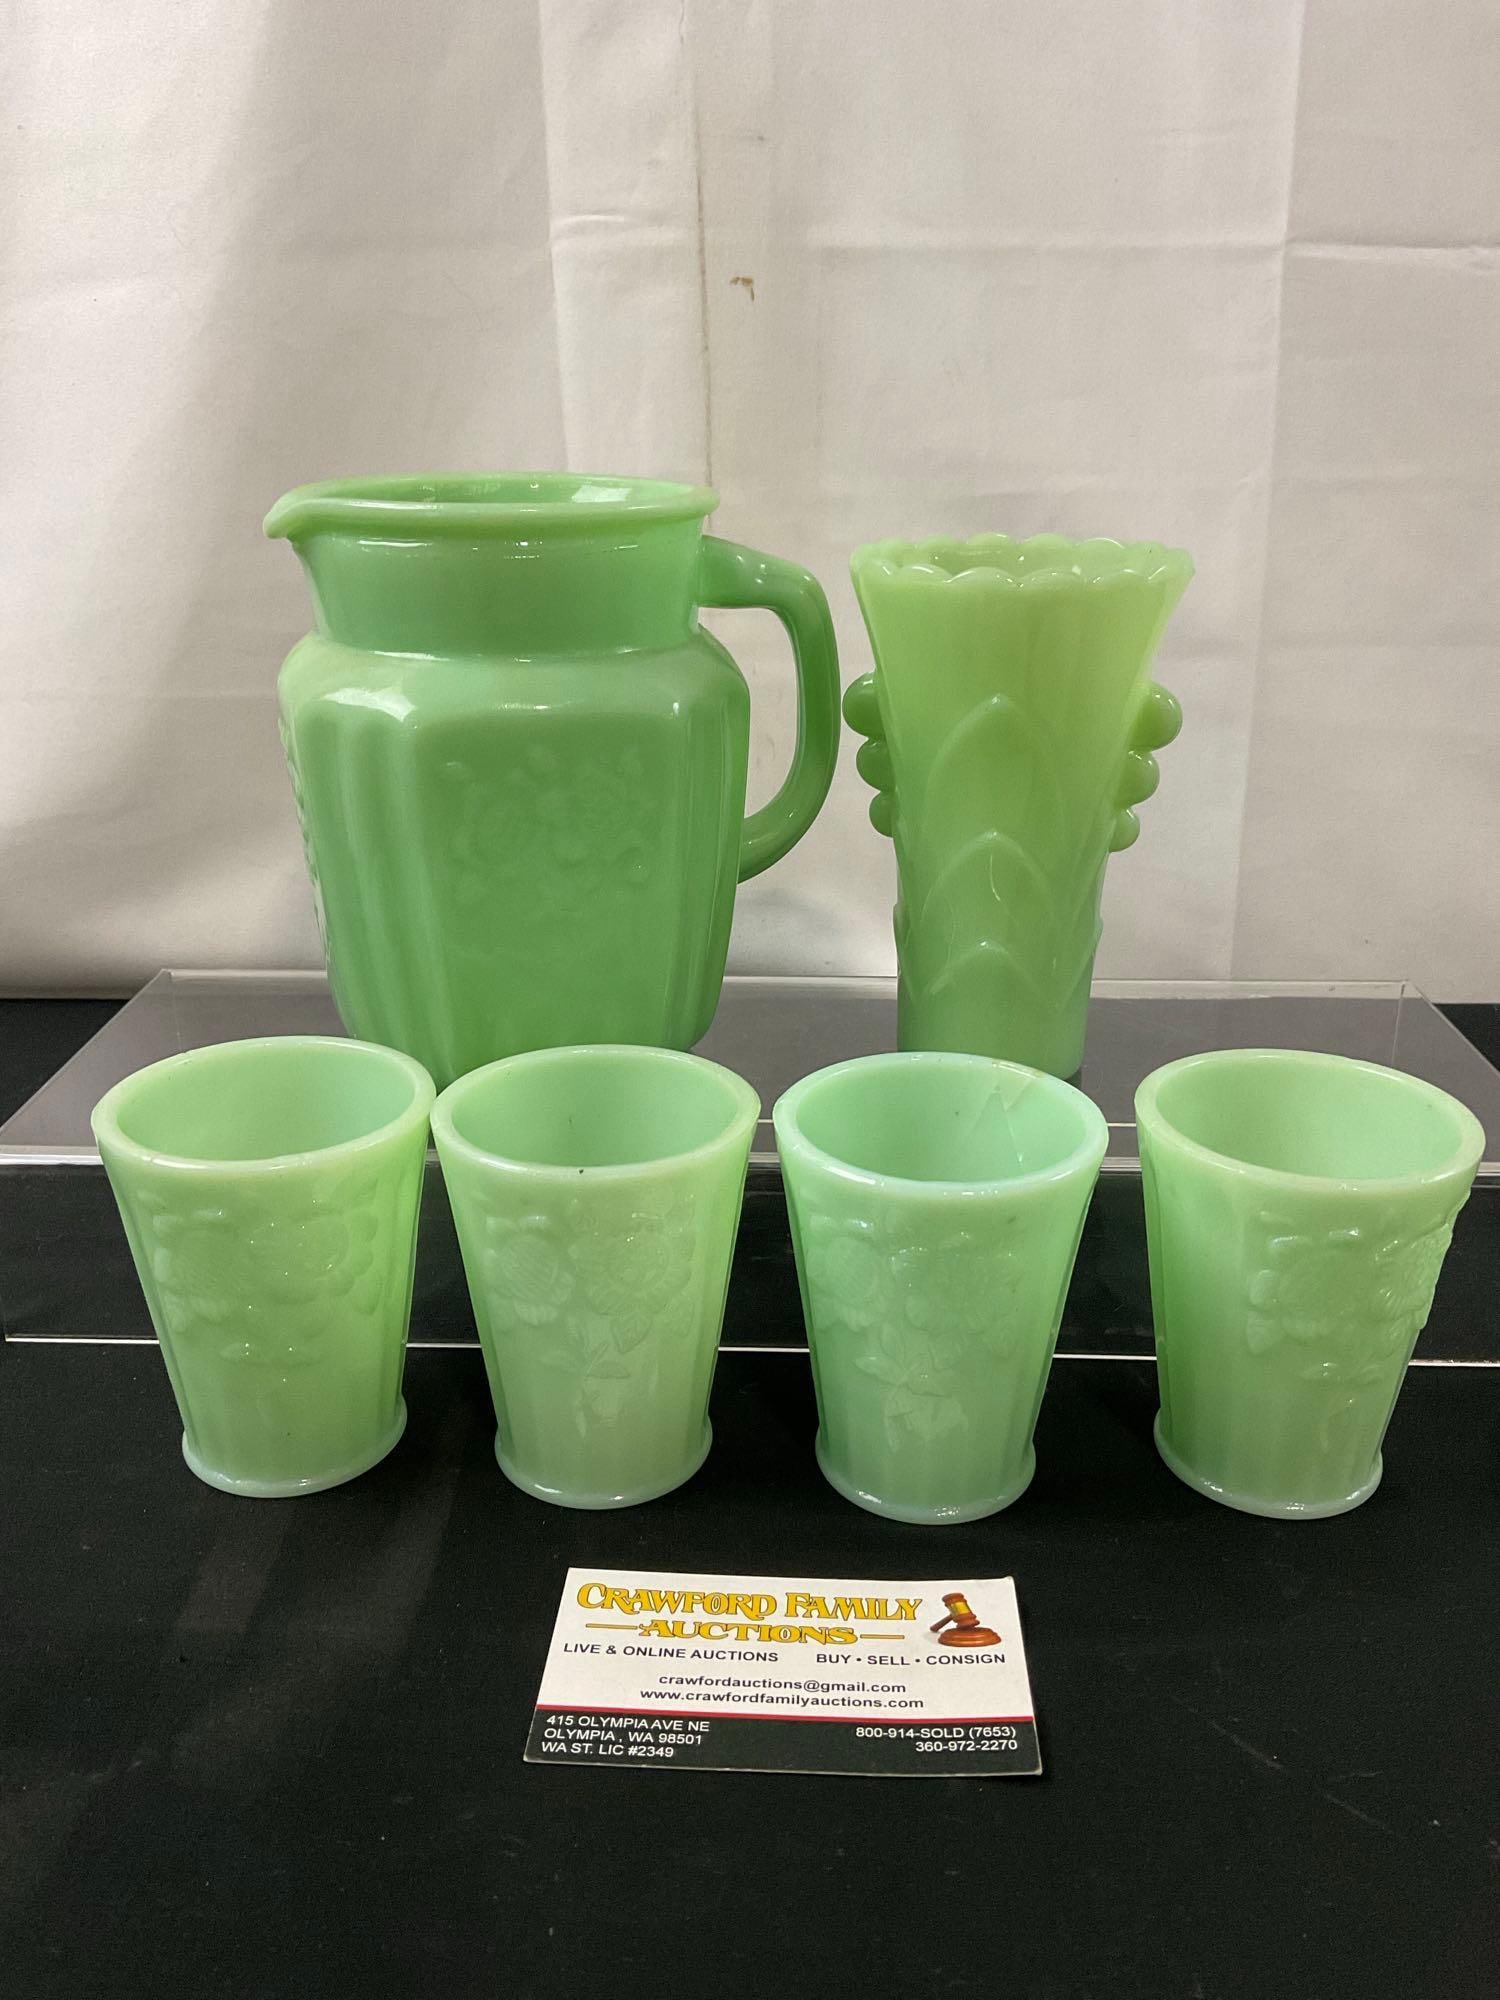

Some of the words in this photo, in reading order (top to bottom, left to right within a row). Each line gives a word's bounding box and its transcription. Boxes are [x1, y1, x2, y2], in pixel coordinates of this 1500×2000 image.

[577, 1583, 777, 1620] CRAWFORD
[785, 1592, 923, 1621] FAMILY
[638, 1619, 859, 1645] AUCTIONS
[563, 1643, 601, 1654] LIVE
[606, 1645, 617, 1655] &
[622, 1645, 687, 1658] ONLINE
[690, 1649, 779, 1662] AUCTIONS
[816, 1653, 851, 1664] BUY
[867, 1655, 910, 1666] SELL
[926, 1653, 1006, 1665] CONSIGN
[659, 1674, 906, 1693] crawfordauctions@gmail.com
[640, 1690, 924, 1708] www.crawfordfamilyauctions.com
[546, 1715, 574, 1726] 415
[578, 1716, 650, 1729] OLYMPIA
[650, 1719, 683, 1731] AVE
[688, 1720, 710, 1732] NE
[628, 1732, 654, 1743] WA
[658, 1733, 702, 1745] 98501
[856, 1727, 965, 1739] 800-914-SOLD
[968, 1726, 1017, 1740] (7653)
[541, 1741, 567, 1752] WA
[571, 1743, 594, 1755] ST.
[599, 1744, 624, 1756] LIC
[628, 1745, 674, 1758] #2349
[915, 1740, 1018, 1752] 360-972-2270
